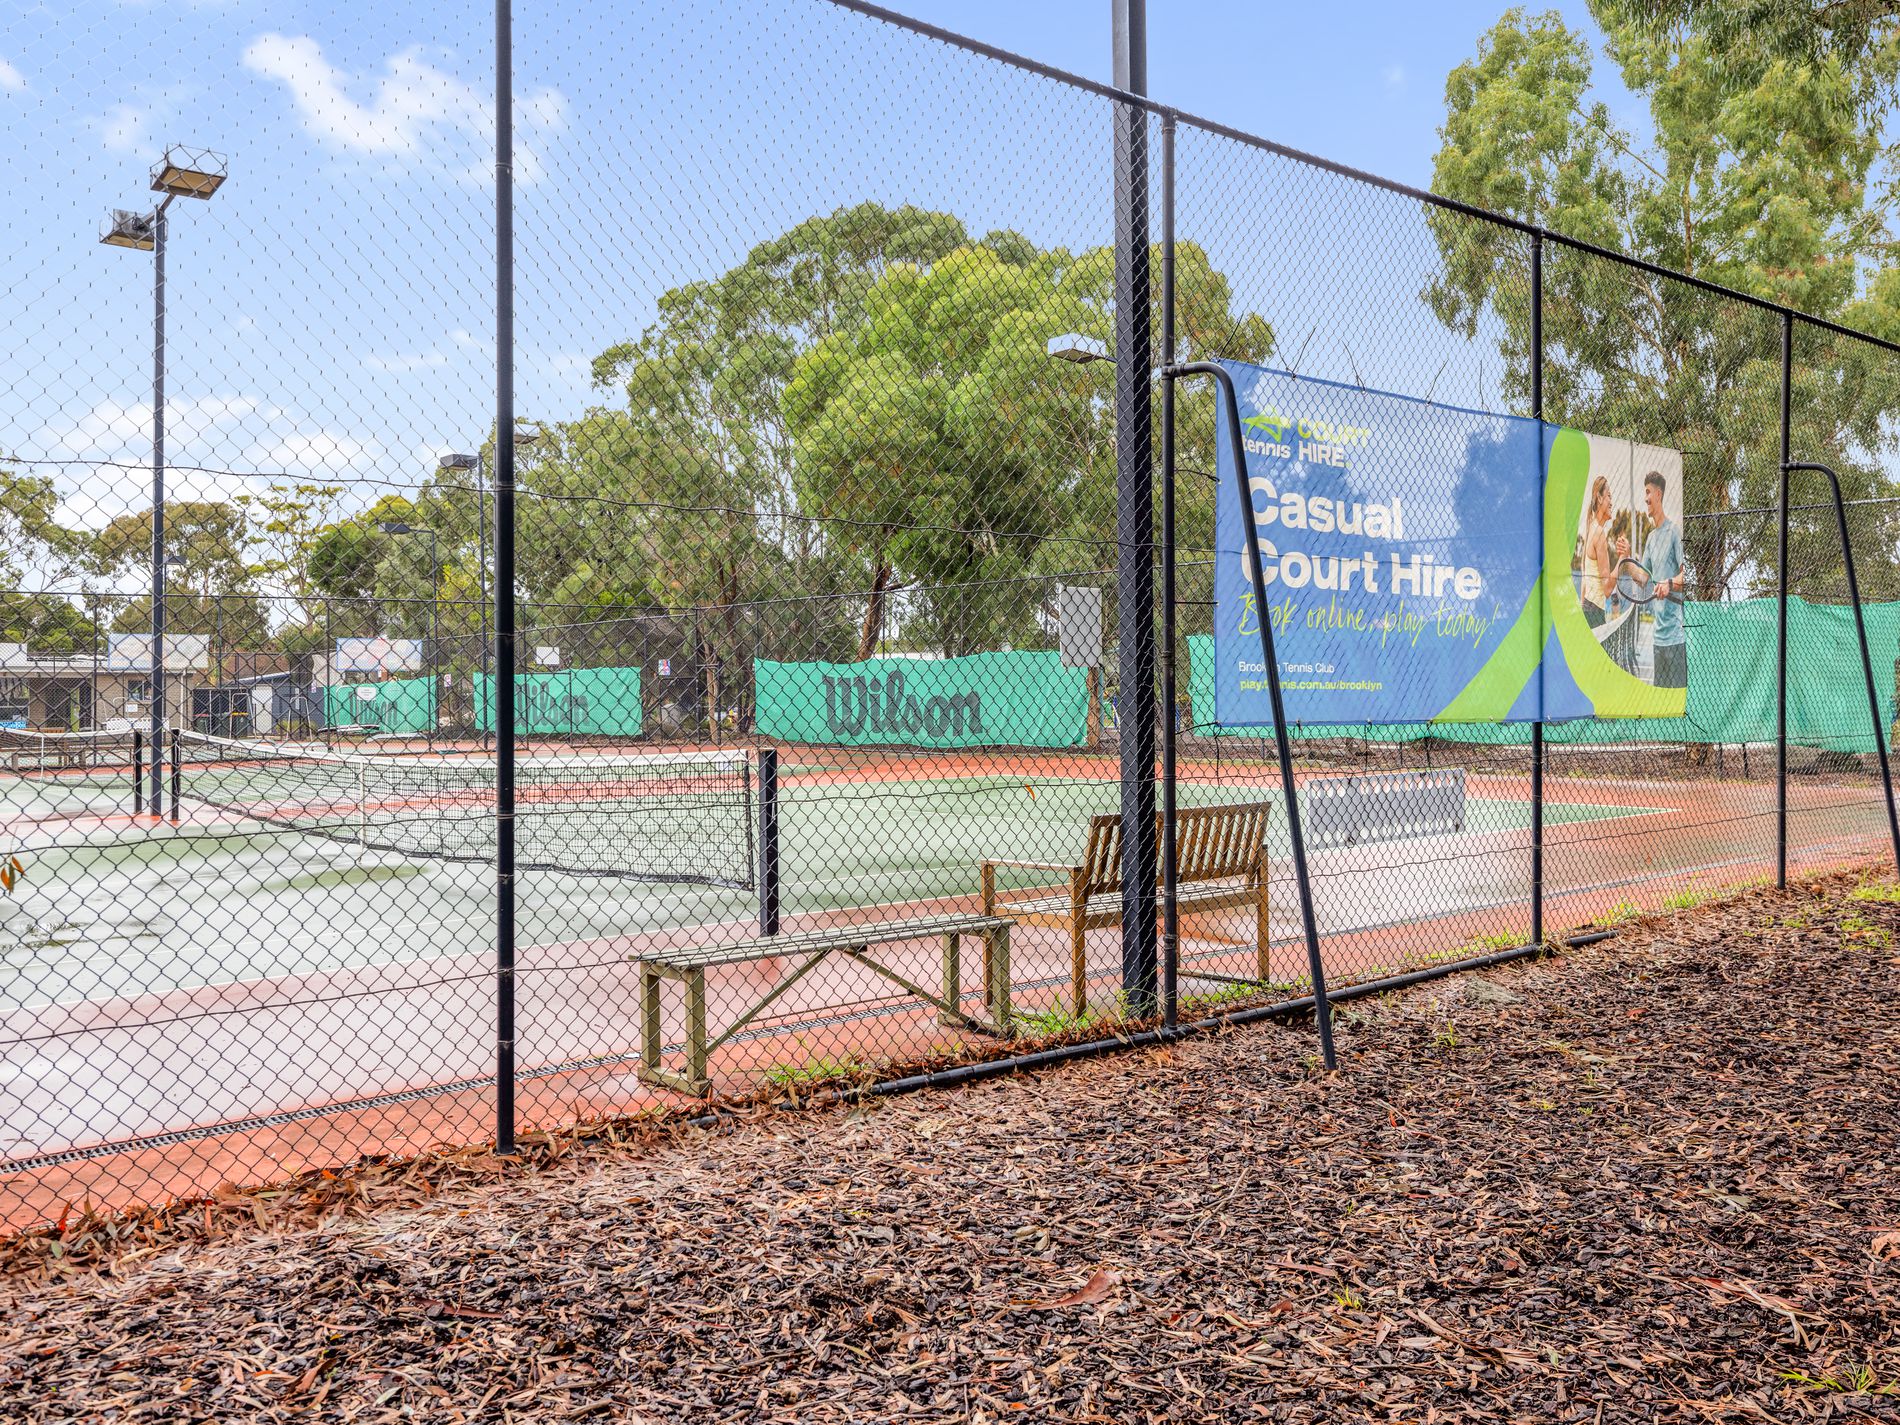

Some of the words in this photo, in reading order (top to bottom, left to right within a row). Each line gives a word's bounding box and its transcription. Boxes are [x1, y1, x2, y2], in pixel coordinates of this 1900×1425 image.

[1241, 434, 1291, 459] tennis
[1247, 476, 1403, 540] Casual
[1241, 537, 1378, 593] Court
[1390, 552, 1482, 600] Hire
[1238, 592, 1297, 636] Bok
[1306, 593, 1374, 634] online,
[1381, 599, 1429, 649] play
[1430, 599, 1500, 649] today!
[1282, 662, 1313, 674] Tennis
[1314, 662, 1335, 674] Club
[822, 670, 984, 738] Wilson
